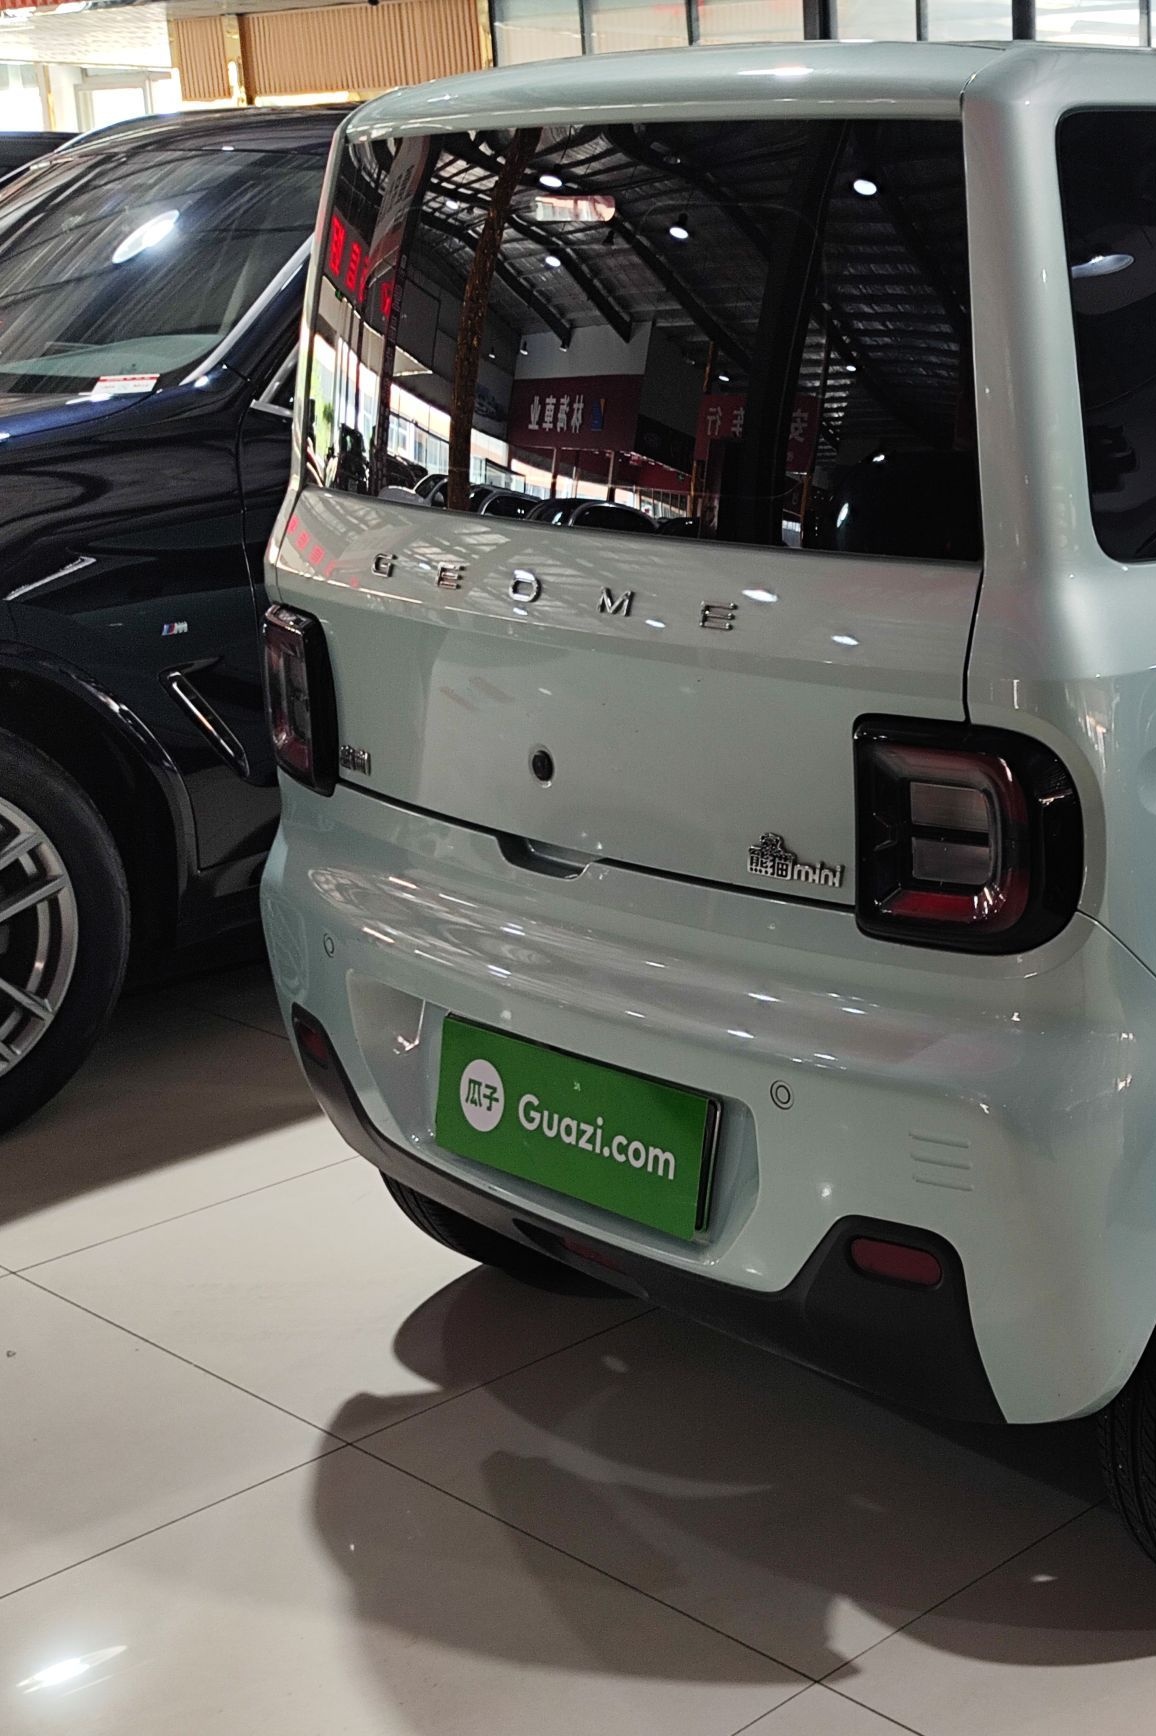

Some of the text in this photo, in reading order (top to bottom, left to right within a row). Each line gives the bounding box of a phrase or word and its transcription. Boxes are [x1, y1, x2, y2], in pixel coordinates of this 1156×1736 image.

[371, 553, 738, 631] GEOME
[466, 1078, 500, 1112] 瓜子
[518, 1093, 676, 1181] Guazi.com
